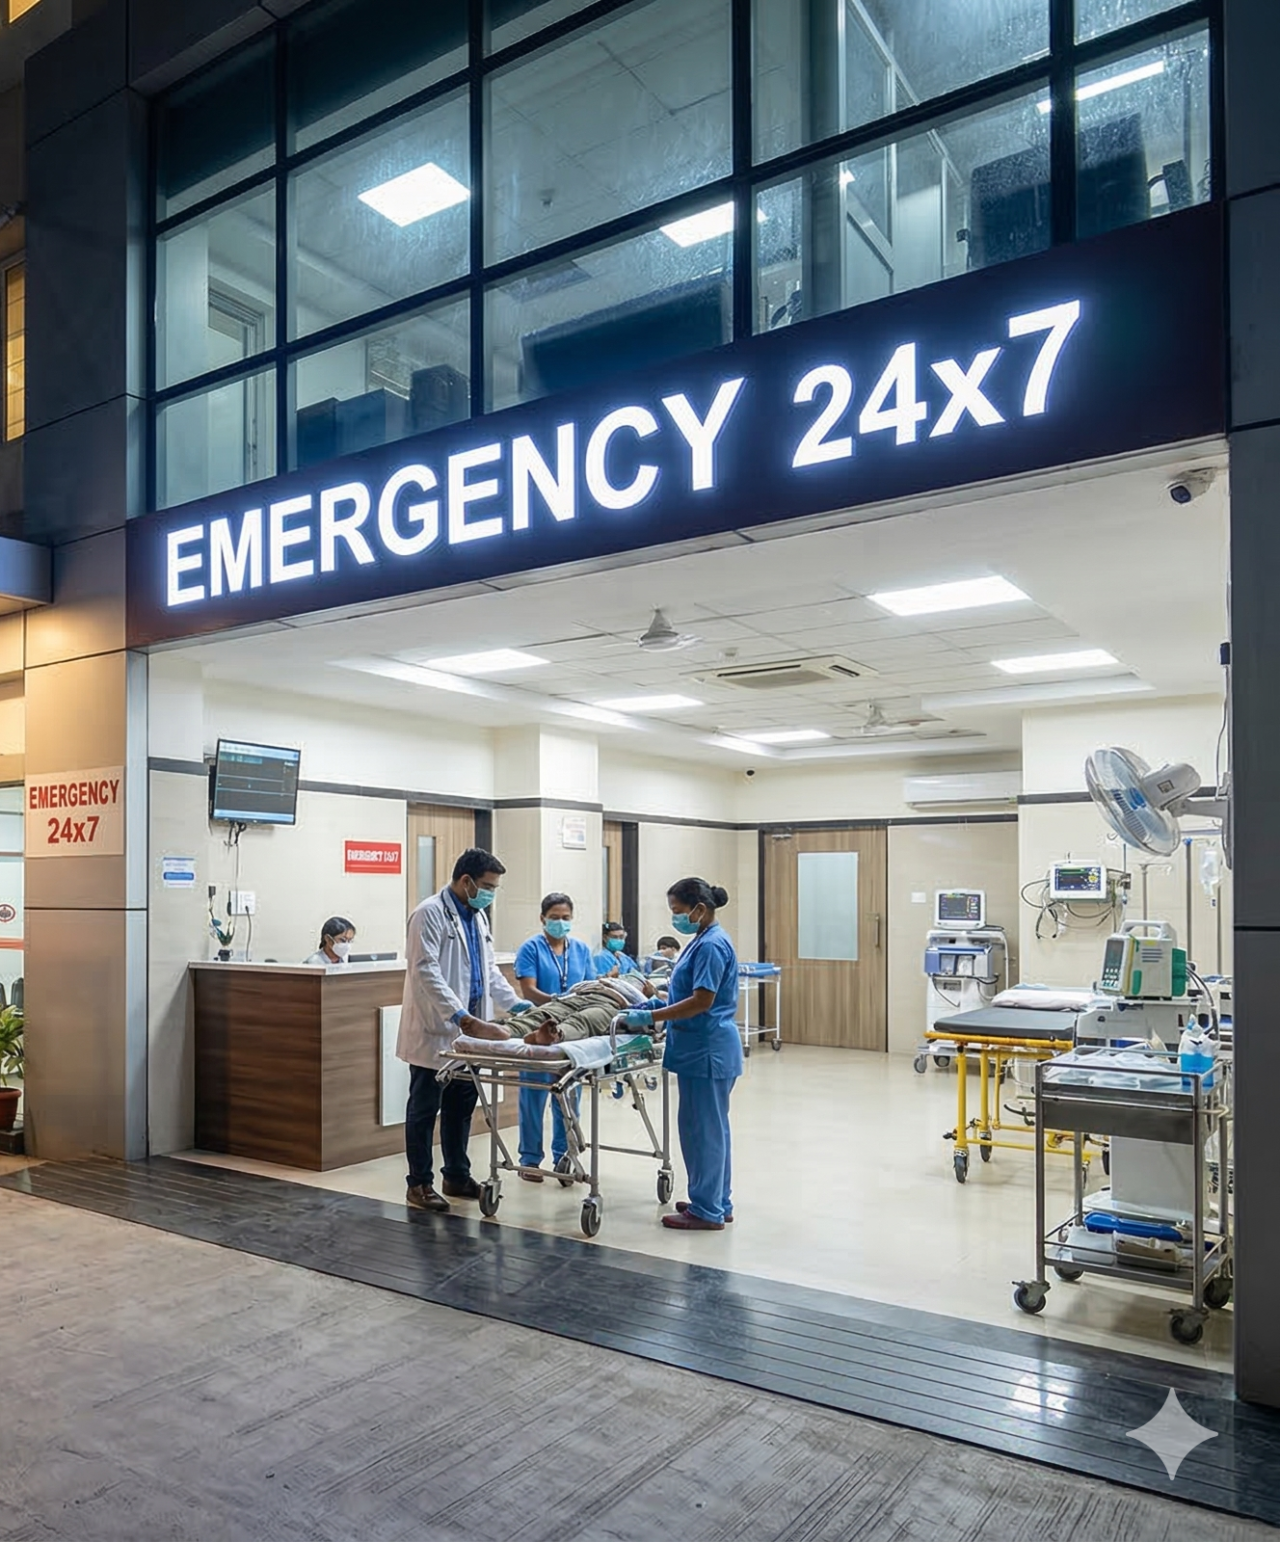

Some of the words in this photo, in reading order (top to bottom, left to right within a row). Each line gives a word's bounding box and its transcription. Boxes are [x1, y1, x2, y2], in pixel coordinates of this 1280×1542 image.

[166, 377, 745, 606] EMERGENCY
[791, 300, 1081, 468] 24x7
[29, 779, 119, 809] EMERGENCY
[48, 816, 99, 844] 24x7
